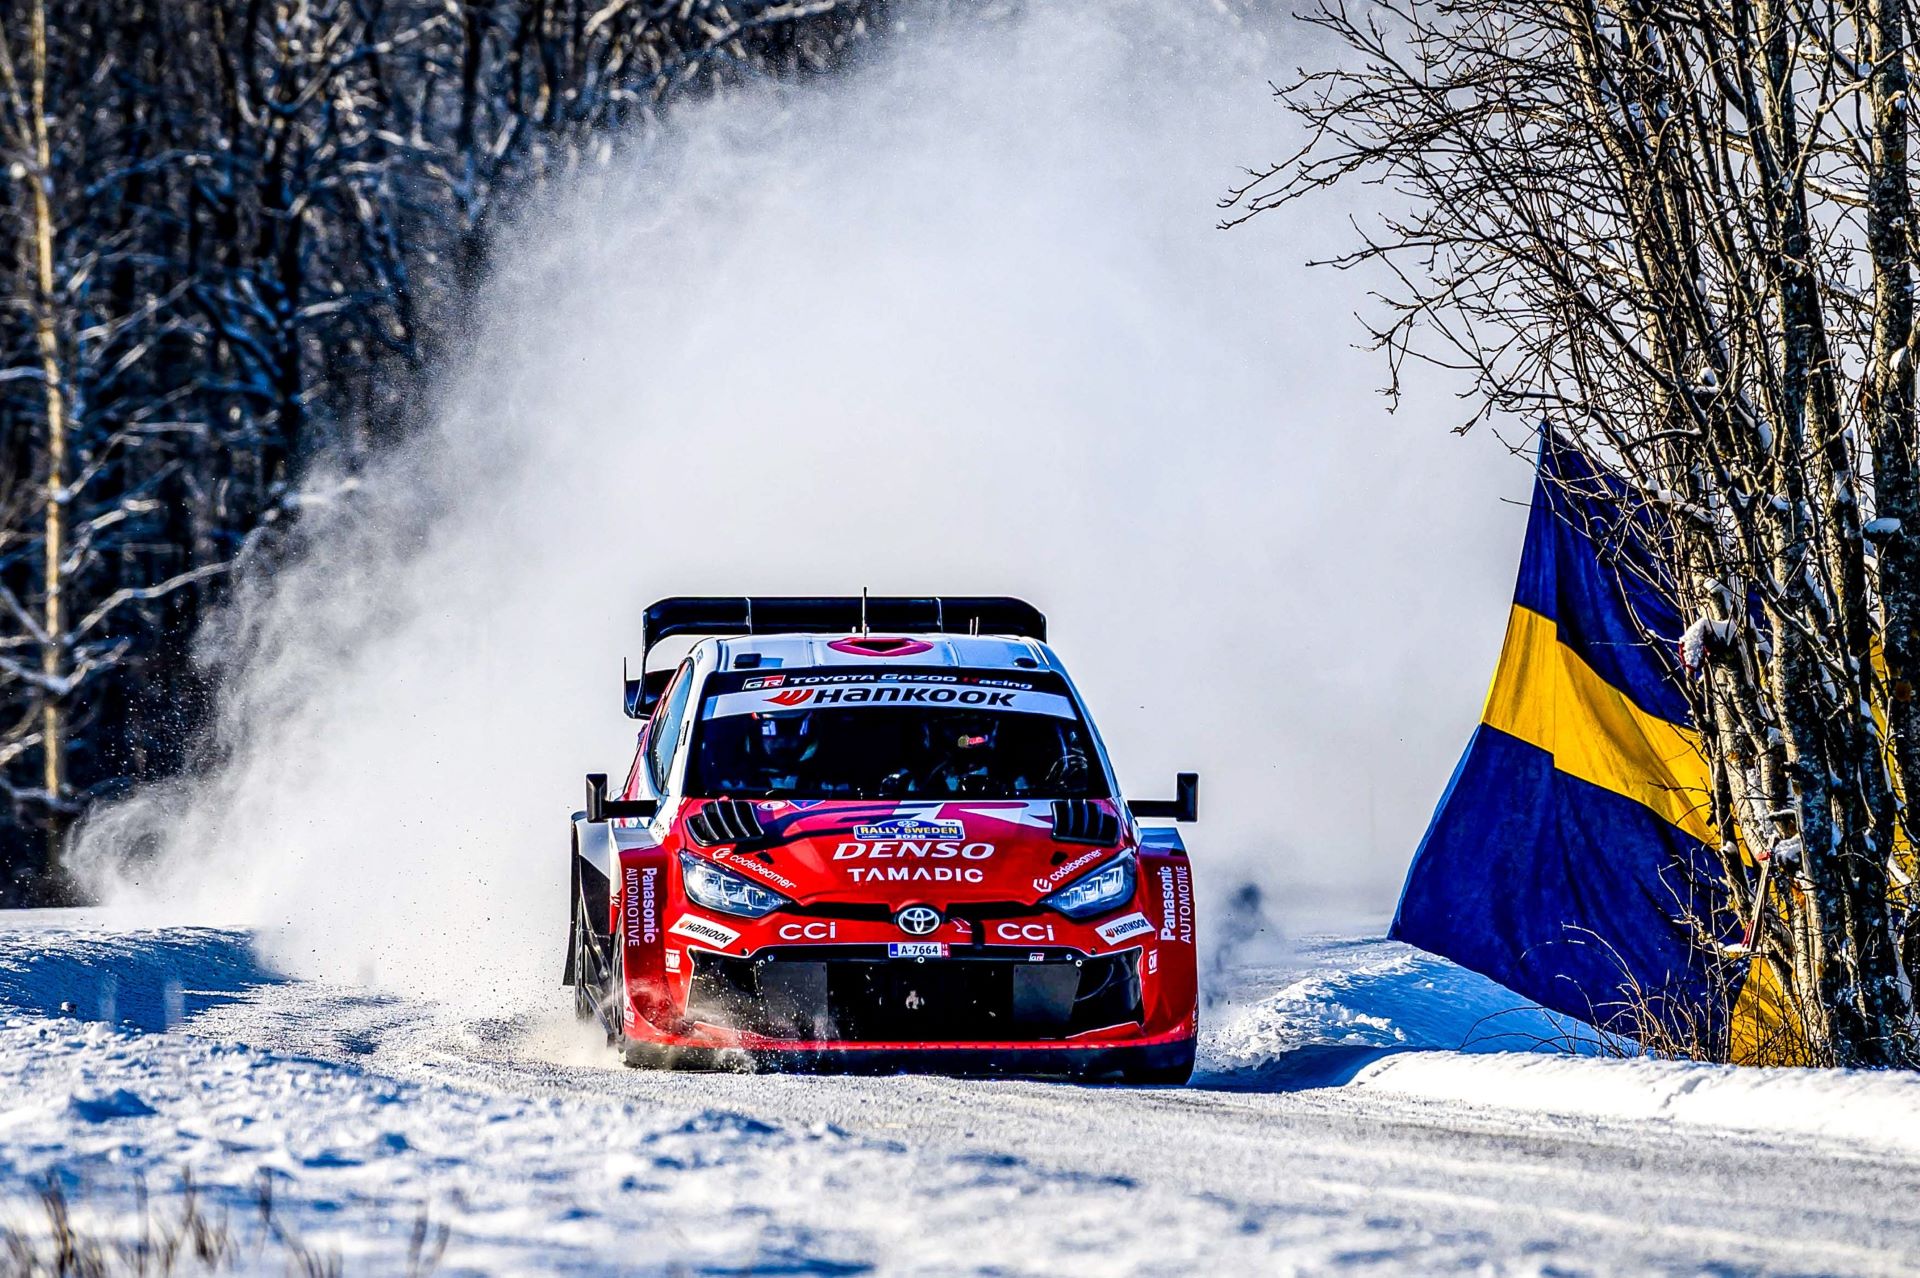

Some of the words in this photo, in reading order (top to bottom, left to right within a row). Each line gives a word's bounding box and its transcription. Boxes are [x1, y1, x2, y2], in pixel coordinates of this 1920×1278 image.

[744, 679, 783, 690] GR
[790, 674, 875, 685] TOYOTA
[880, 673, 957, 682] GAZOO
[962, 677, 1033, 690] Racing
[904, 827, 958, 835] SWEDEN
[833, 841, 995, 860] DENSO
[729, 855, 796, 889] codebeamer
[847, 867, 984, 883] TAMADIC
[1050, 849, 1102, 881] codebeamer
[626, 868, 640, 947] AUTOMOTIVE
[642, 867, 659, 944] Panasonic
[1157, 866, 1176, 941] Panasonic
[1176, 866, 1192, 944] AUTOMOTIVE
[901, 945, 939, 955] A-7664
